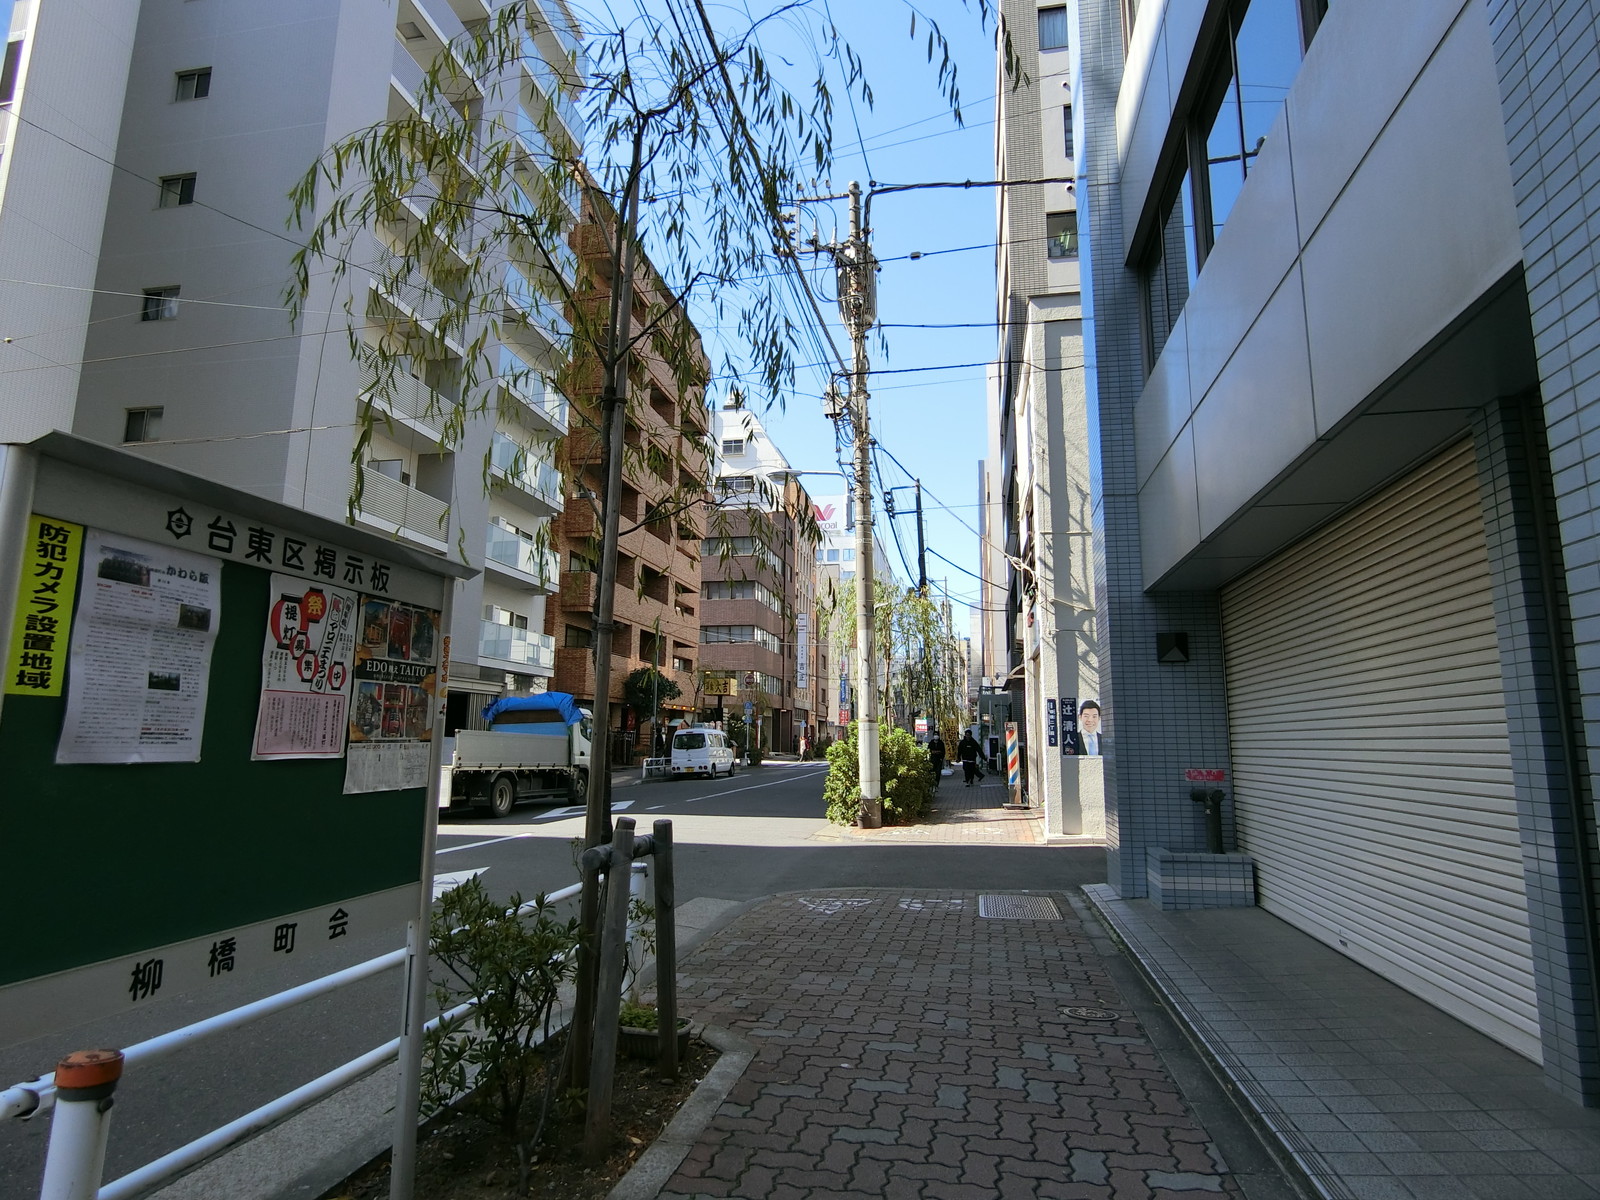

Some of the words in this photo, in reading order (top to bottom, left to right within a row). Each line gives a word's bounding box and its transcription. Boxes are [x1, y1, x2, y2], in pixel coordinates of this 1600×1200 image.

[208, 516, 390, 593] 台東区掲示板
[16, 522, 71, 689] 防犯カメラ設置地域
[283, 603, 297, 641] 提灯
[333, 670, 341, 682] 中
[308, 595, 322, 615] 祭
[366, 660, 388, 673] EDO
[400, 664, 426, 677] TAITO
[1062, 704, 1074, 745] 辻清人
[129, 907, 349, 1001] 柳橋町会
